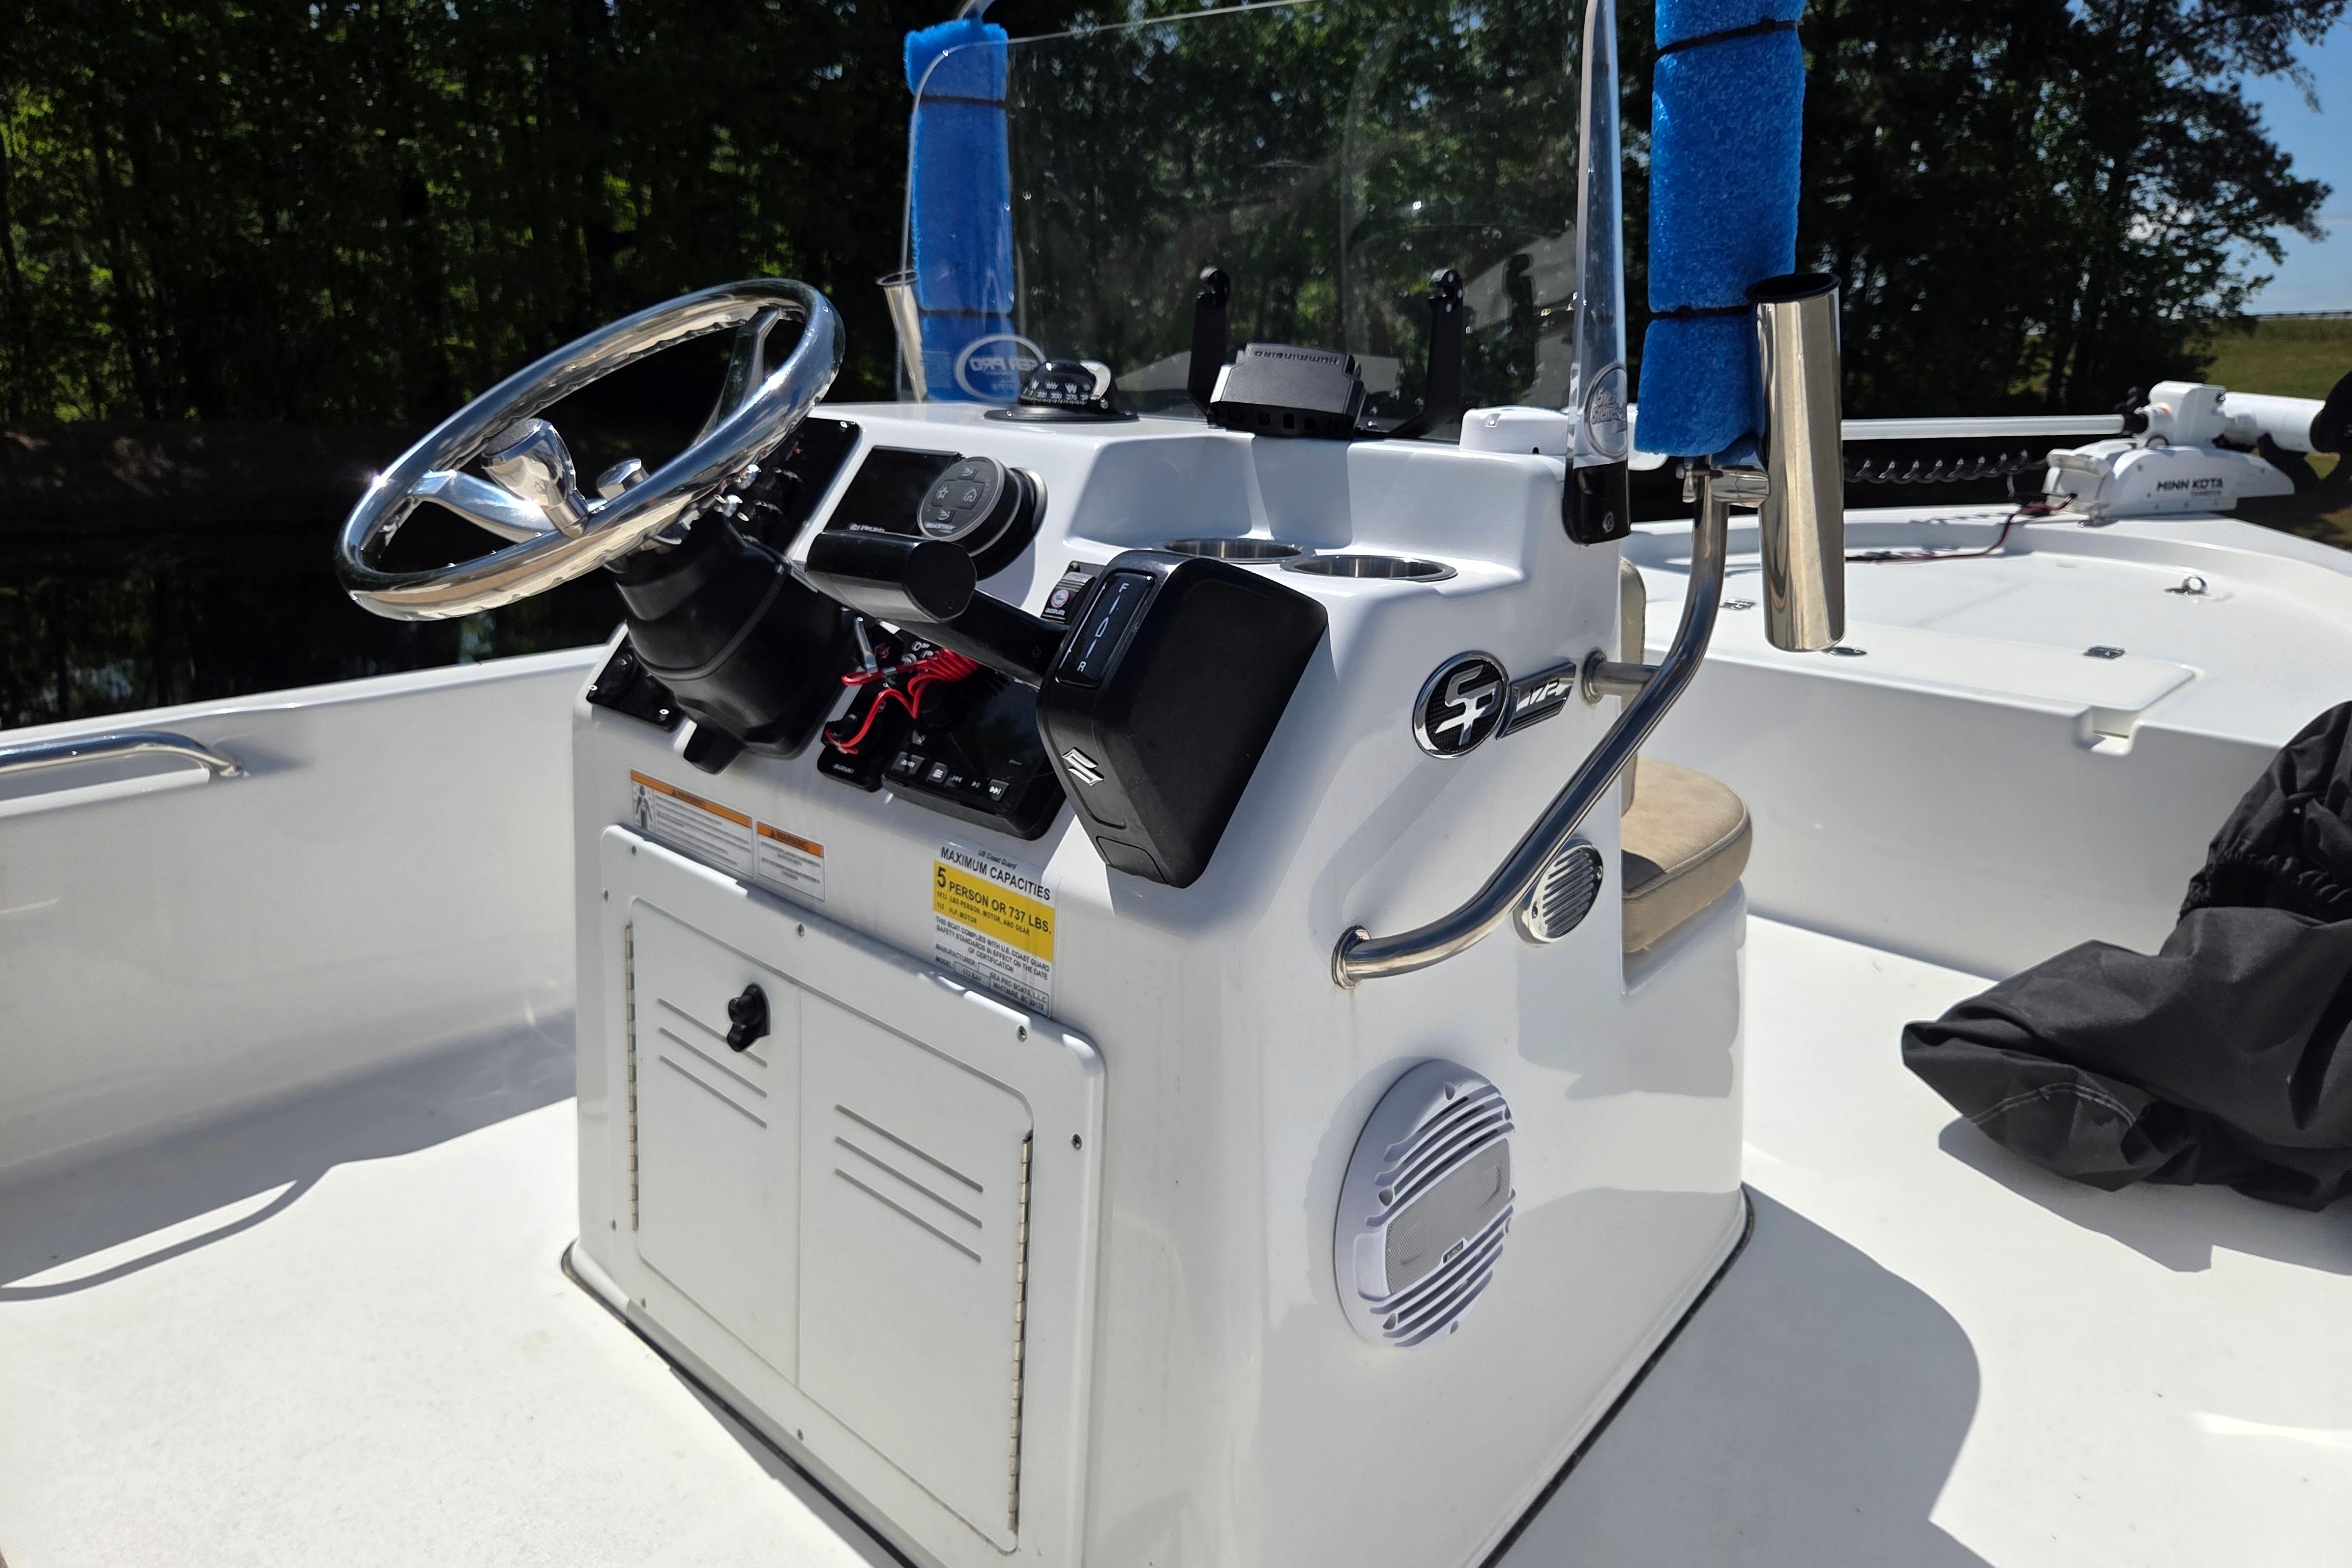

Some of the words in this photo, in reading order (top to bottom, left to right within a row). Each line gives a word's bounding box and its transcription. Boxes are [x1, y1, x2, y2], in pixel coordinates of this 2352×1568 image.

[2156, 480, 2189, 492] MINN
[2193, 477, 2223, 489] KOTA
[1119, 583, 1129, 593] F
[1077, 661, 1087, 672] R
[1001, 858, 1017, 870] Guard
[941, 845, 987, 876] MAXIMUM
[990, 865, 1050, 901] CAPACITIES
[937, 865, 946, 890] 5
[950, 881, 988, 907] PERSON
[992, 898, 1006, 915] OR
[1009, 906, 1025, 923] 737
[1029, 914, 1051, 934] LBS.
[960, 911, 977, 924] MOTOR
[1004, 919, 1014, 929] AND
[1015, 924, 1029, 935] GEAR
[936, 915, 946, 925] THIS
[947, 921, 960, 932] BOAT
[961, 927, 985, 943] COMPLIES
[987, 938, 1000, 950] WITH
[1011, 949, 1030, 963] COAST
[1031, 958, 1050, 972] GUARD
[936, 924, 954, 937] SAFETY
[956, 932, 985, 951] STANDARDS
[993, 950, 1012, 964] EFFECT
[1013, 959, 1021, 968] ON
[1023, 962, 1032, 973] THE
[1034, 968, 1048, 980] DATE
[968, 946, 975, 955] OF
[976, 950, 1014, 972] CERTIFICATION
[1001, 977, 1011, 987] PRO
